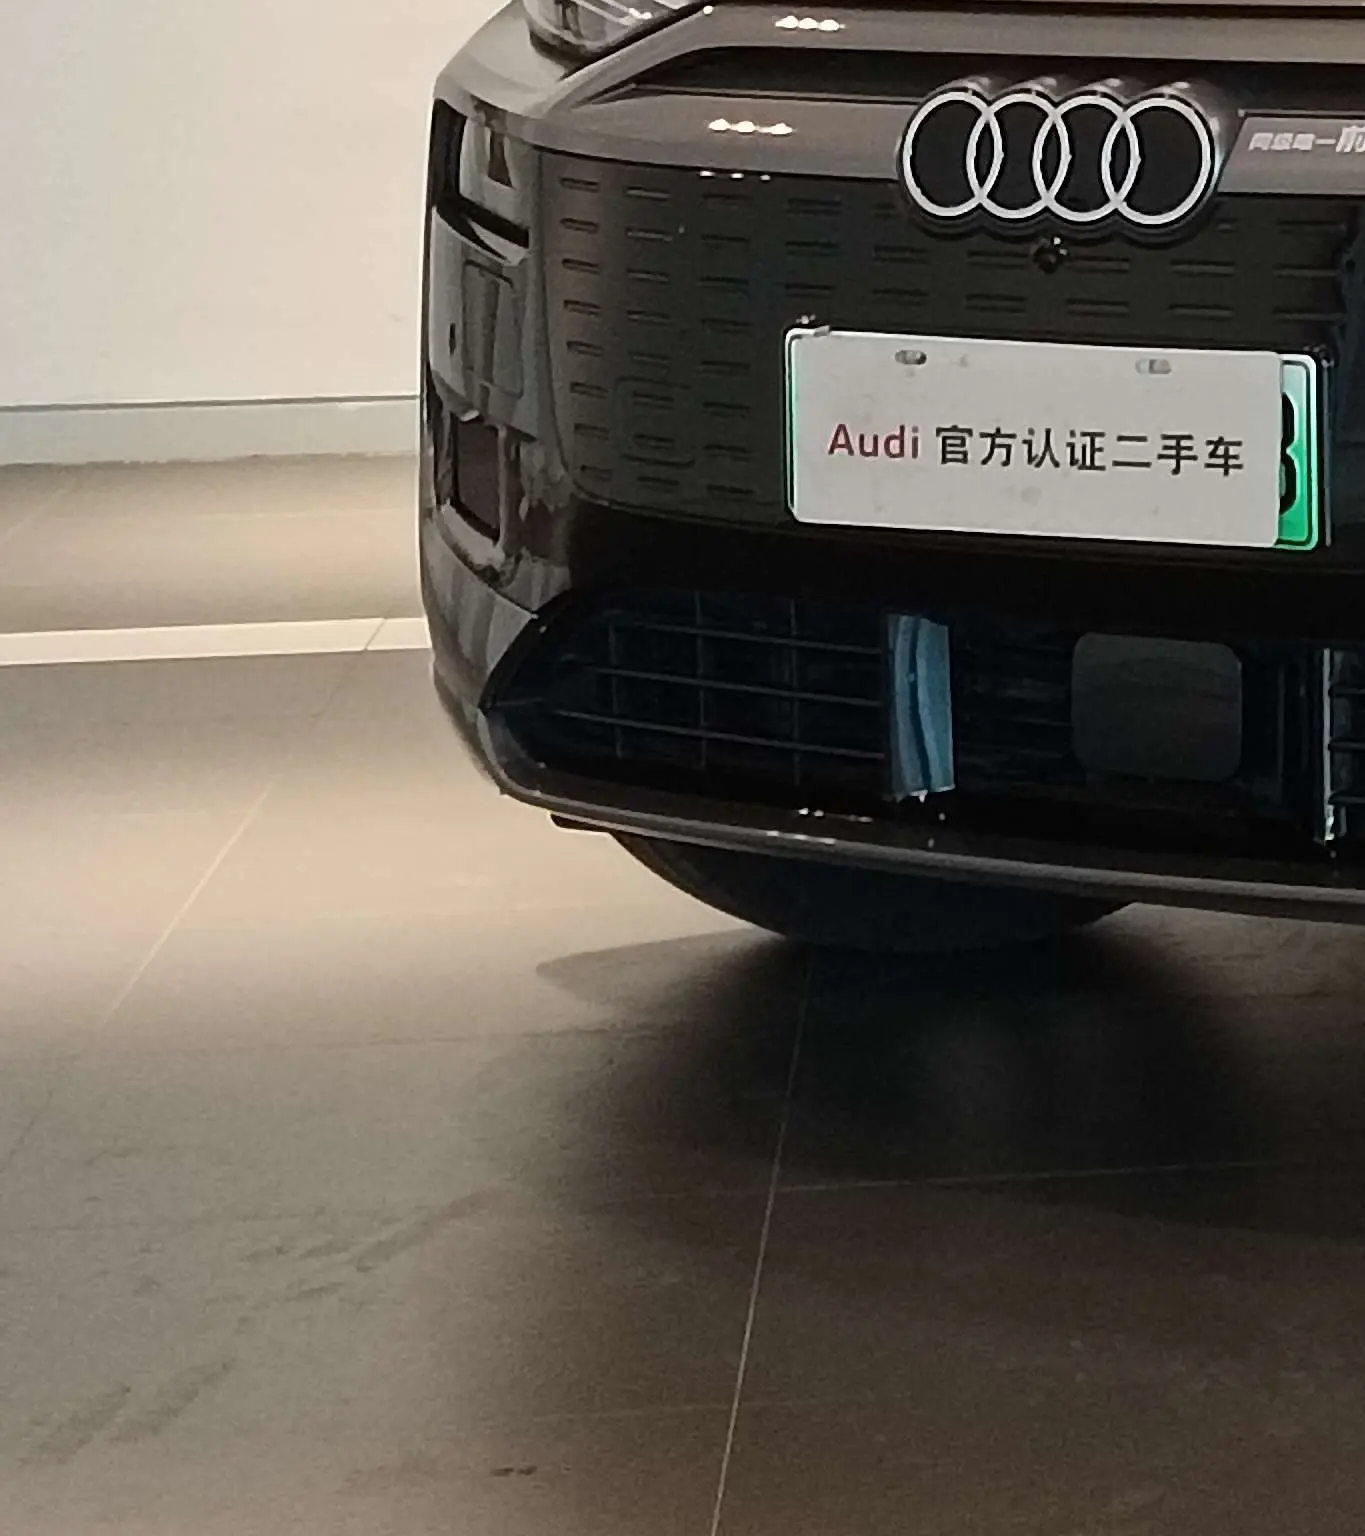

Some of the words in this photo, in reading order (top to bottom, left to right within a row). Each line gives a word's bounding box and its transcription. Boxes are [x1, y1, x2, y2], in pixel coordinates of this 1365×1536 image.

[827, 422, 920, 460] Audi
[935, 424, 1244, 477] 官方认证二手车
